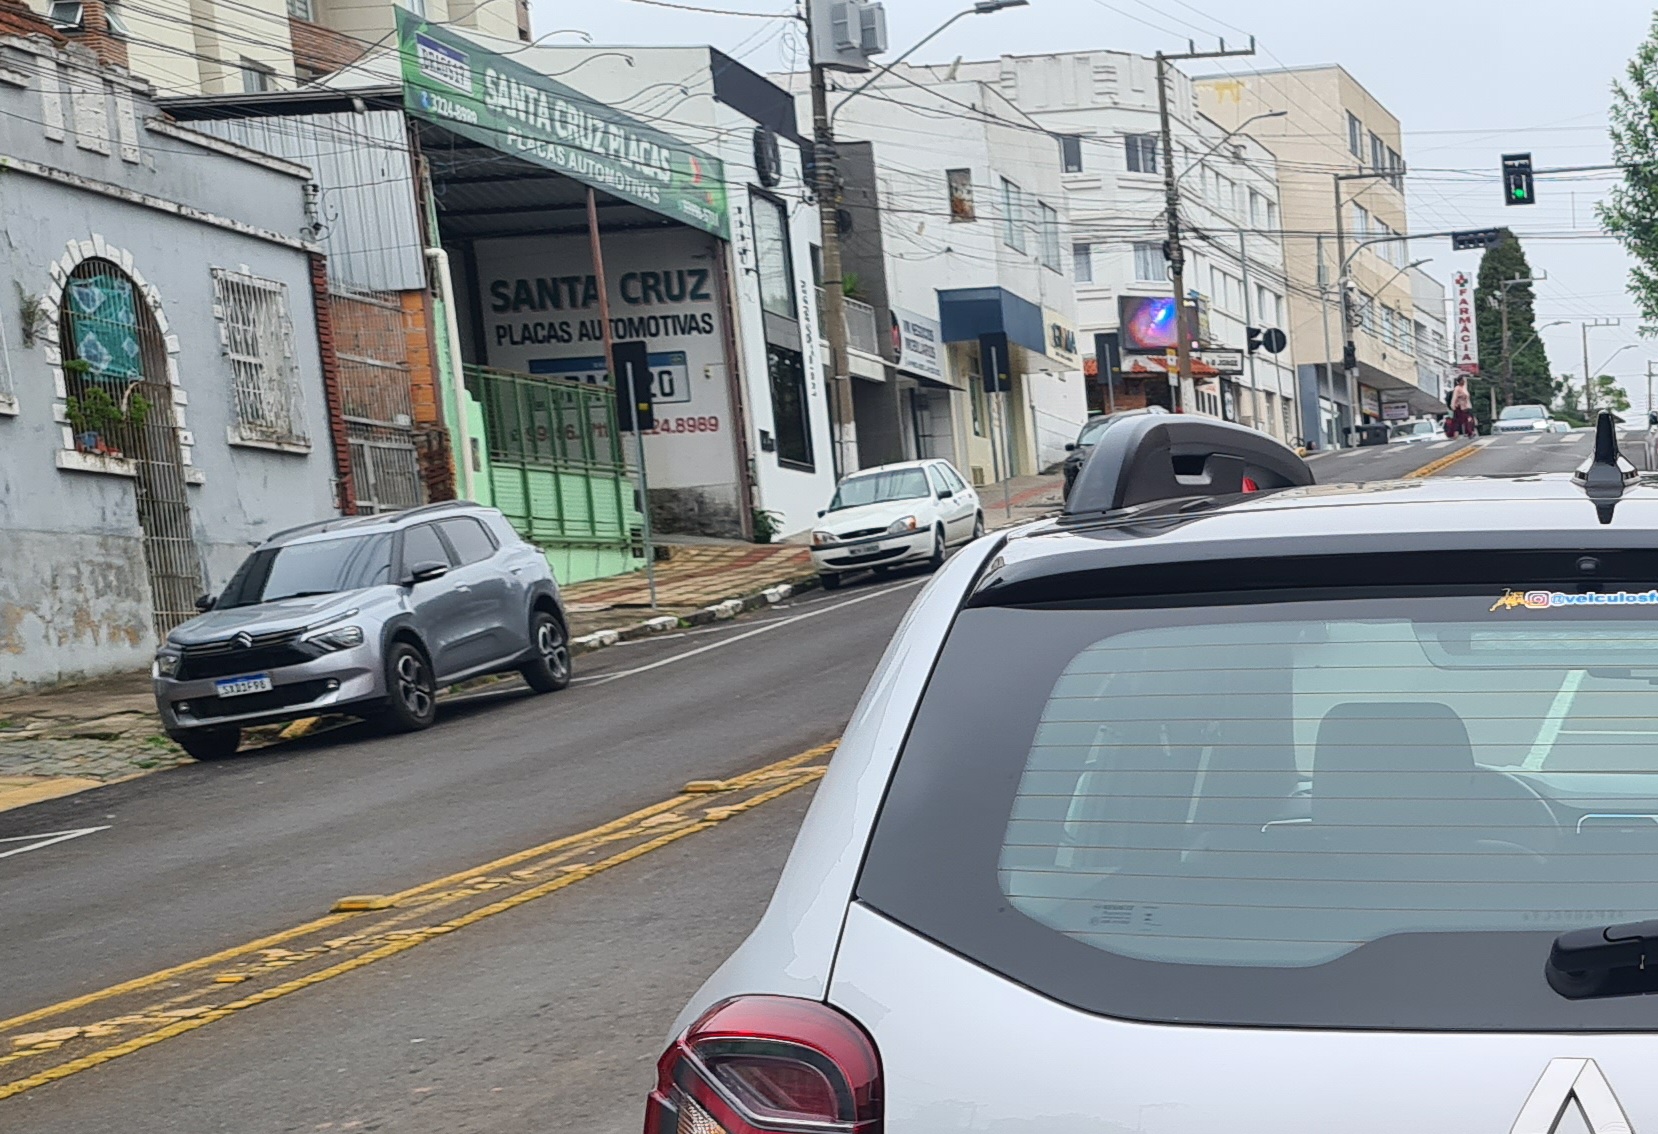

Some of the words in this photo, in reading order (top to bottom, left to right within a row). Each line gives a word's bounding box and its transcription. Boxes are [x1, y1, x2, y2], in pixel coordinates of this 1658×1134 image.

[483, 67, 551, 134] SANTA
[554, 100, 605, 154] CRUZ
[608, 124, 672, 184] PLACAS
[506, 125, 566, 166] PLACAS
[566, 151, 661, 205] AUTOMOTIVAS
[490, 275, 608, 314] SANTA
[620, 268, 711, 305] CRUZ
[496, 321, 573, 346] PLACAS
[578, 312, 714, 343] AUTOMOTIVAS
